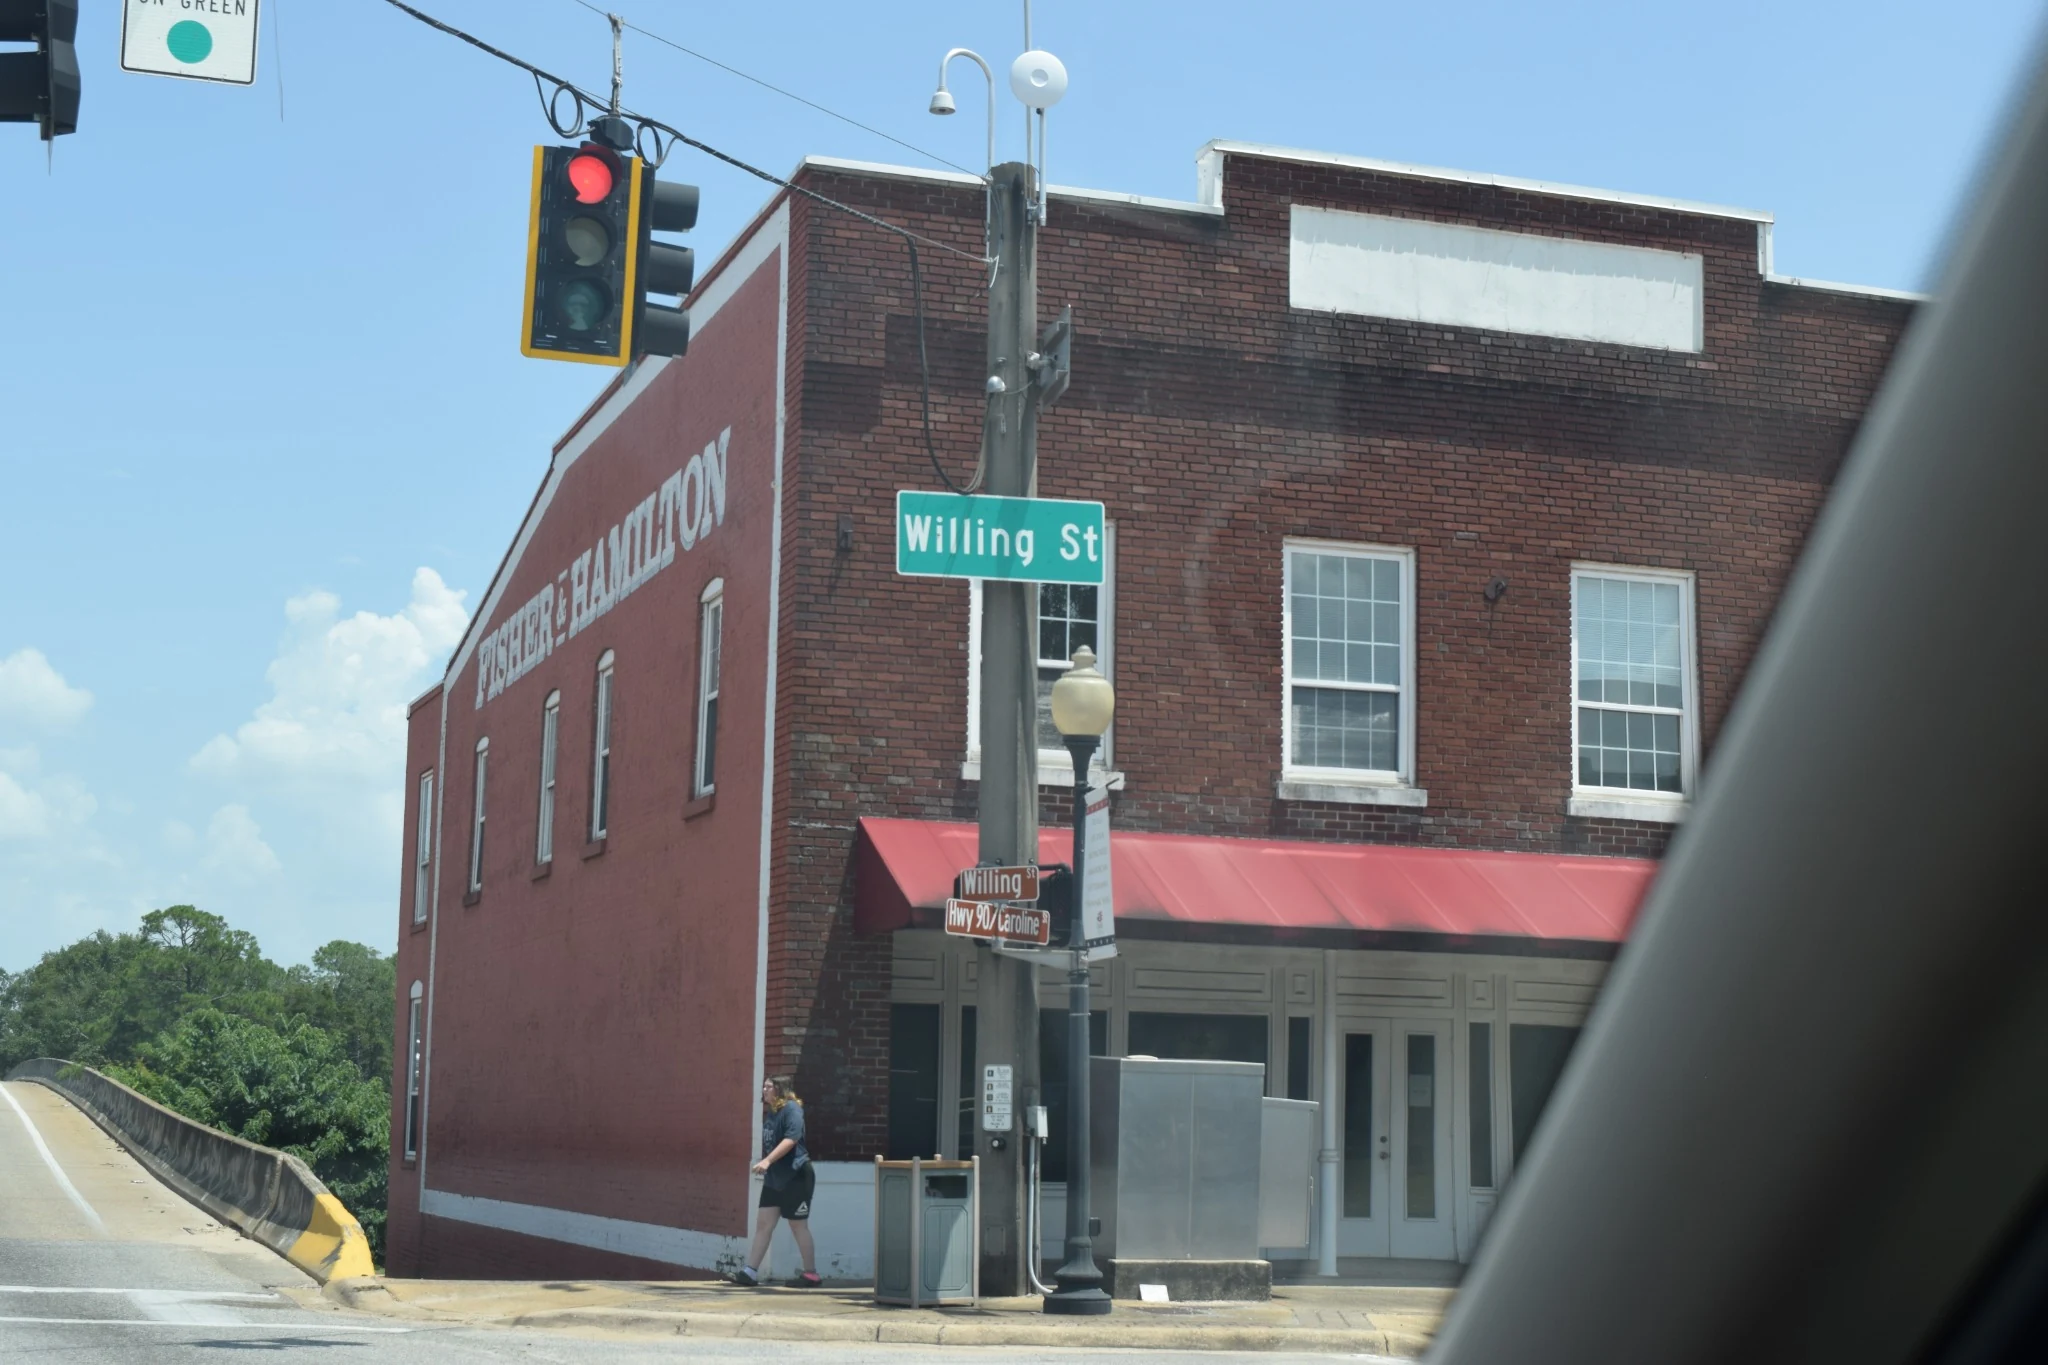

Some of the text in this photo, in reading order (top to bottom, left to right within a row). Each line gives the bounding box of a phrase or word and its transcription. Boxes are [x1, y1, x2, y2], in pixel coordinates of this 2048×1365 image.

[904, 514, 1098, 567] Willing St
[475, 582, 555, 711] FISHER
[569, 425, 731, 640] HAMILTON
[964, 868, 1036, 898] Willing St
[949, 901, 974, 932] Hwy
